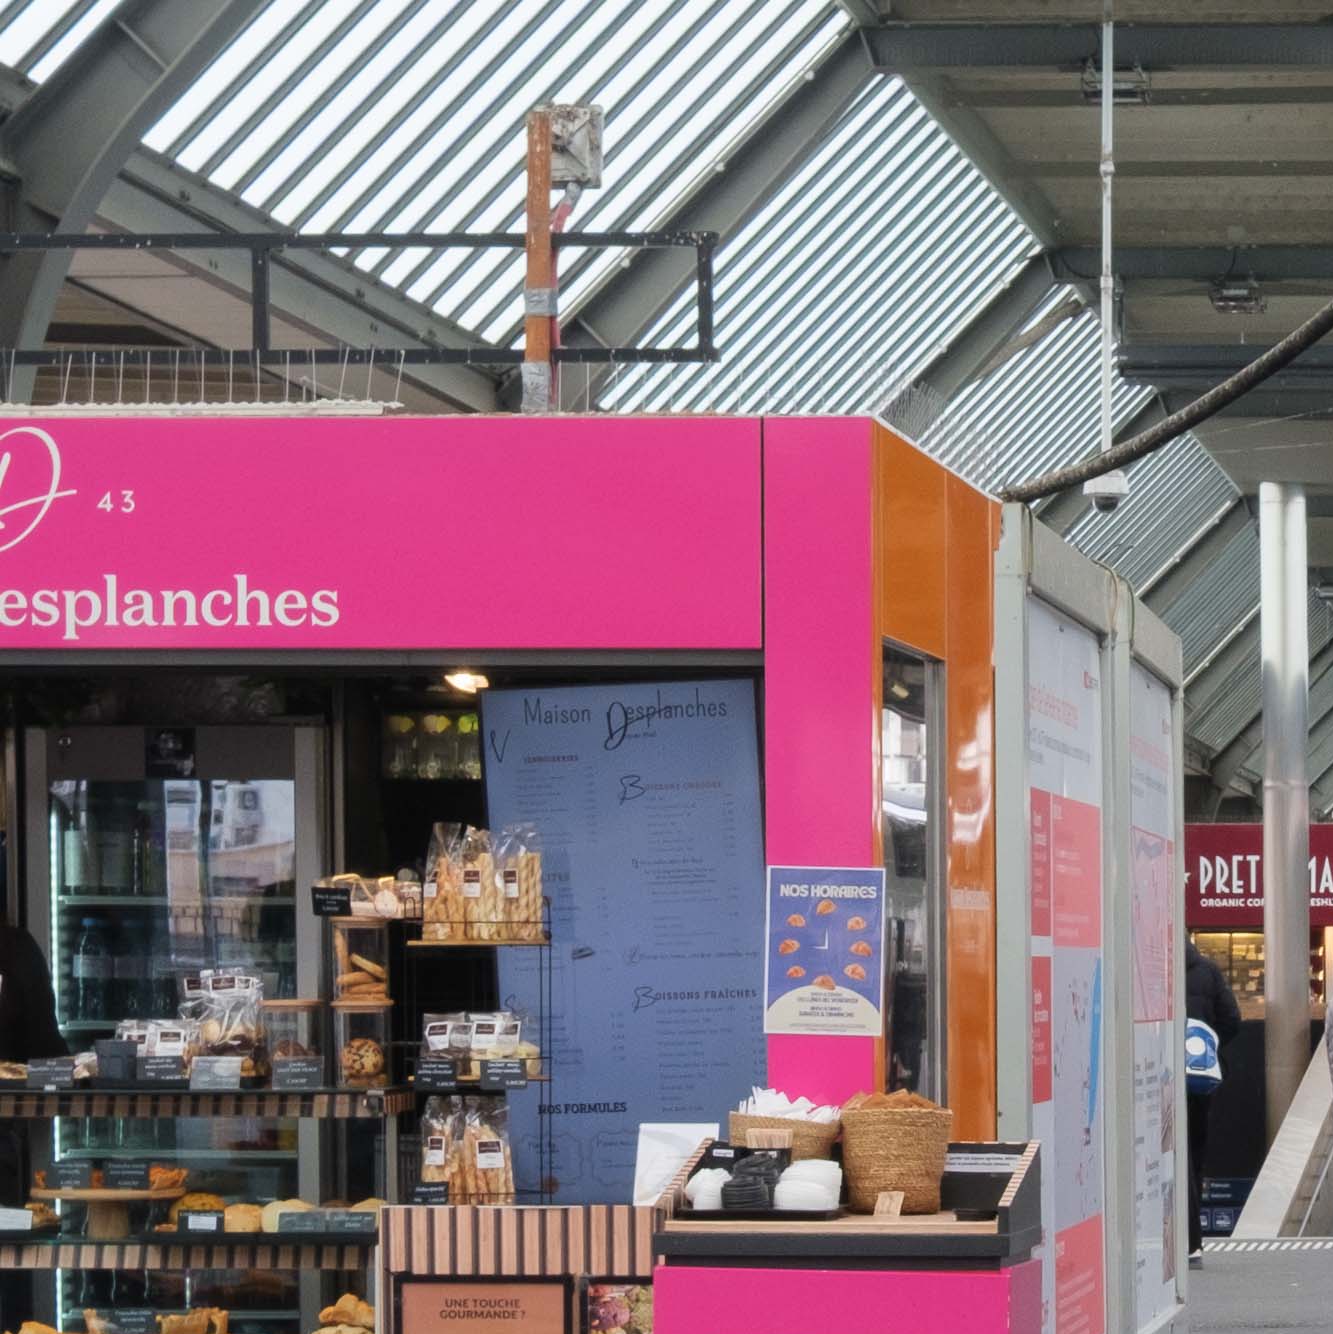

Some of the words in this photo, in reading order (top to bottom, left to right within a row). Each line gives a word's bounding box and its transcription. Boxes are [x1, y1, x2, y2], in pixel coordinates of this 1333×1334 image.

[97, 490, 136, 513] 43
[0, 574, 340, 640] esplanches
[523, 697, 591, 725] Maison
[604, 687, 728, 751] Desplanches
[1199, 855, 1261, 894] PRET
[780, 884, 809, 897] NOS
[810, 885, 877, 899] HORAIRES
[1200, 898, 1245, 908] ORGANIC
[633, 986, 700, 1012] BOISSONS
[704, 987, 757, 999] FRAÎCHES
[538, 1103, 561, 1114] NOS
[564, 1103, 627, 1114] FORMULES
[445, 1299, 468, 1309] UNE
[473, 1299, 520, 1309] TOUCHE
[440, 1311, 517, 1319] GOURMANDE
